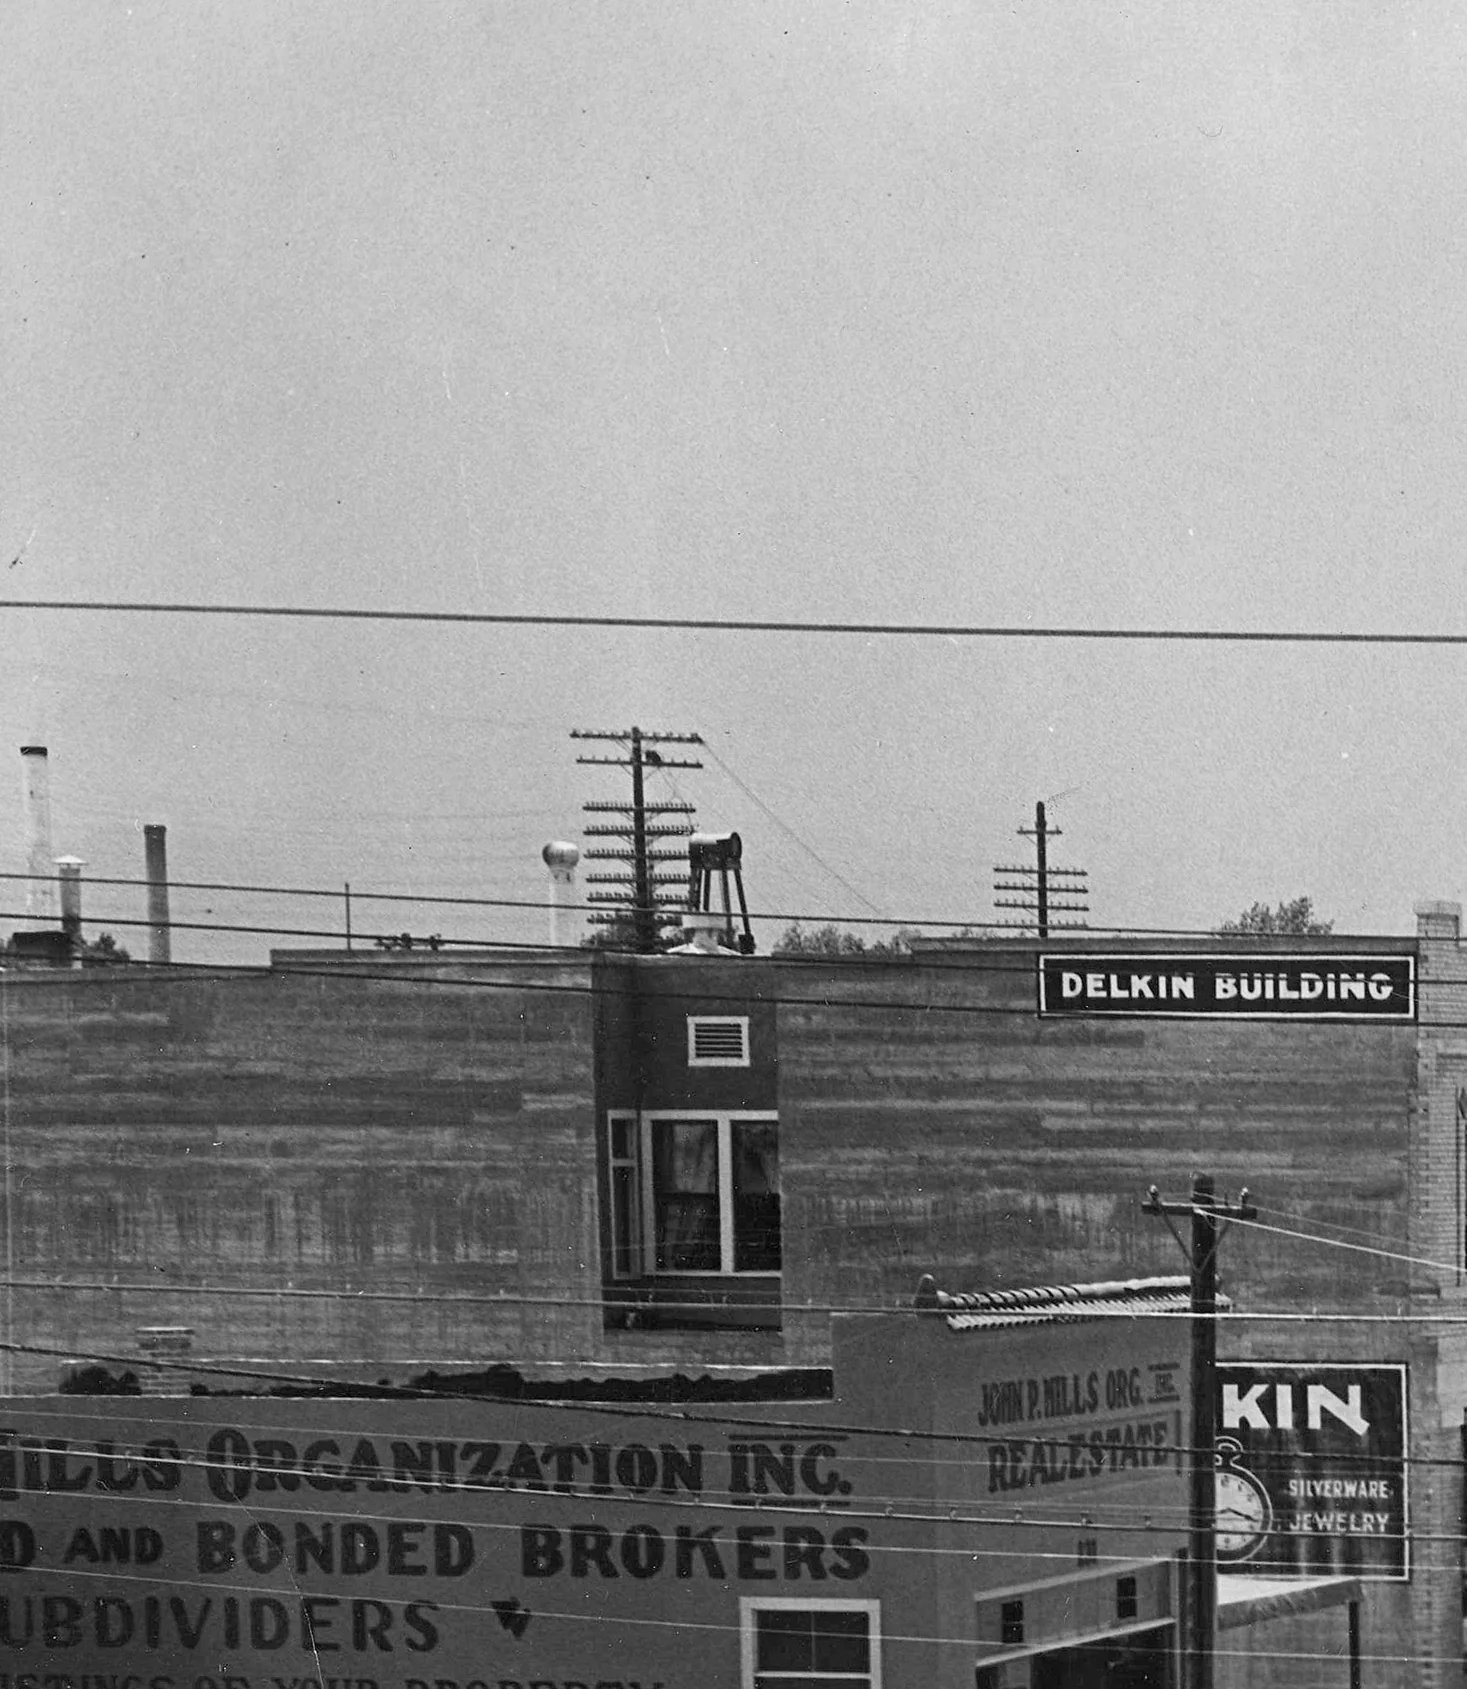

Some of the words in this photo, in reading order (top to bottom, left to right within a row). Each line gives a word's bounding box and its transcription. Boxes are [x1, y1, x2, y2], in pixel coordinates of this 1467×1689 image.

[1062, 972, 1195, 998] DELKIN
[1215, 973, 1394, 1000] BUILDING
[207, 1429, 704, 1501] ORGANIZATION
[727, 1443, 853, 1496] INC.
[1289, 1513, 1390, 1532] JEWELRY
[62, 1527, 164, 1564] AND
[197, 1521, 475, 1577] BONDED
[521, 1523, 870, 1580] BROKERS
